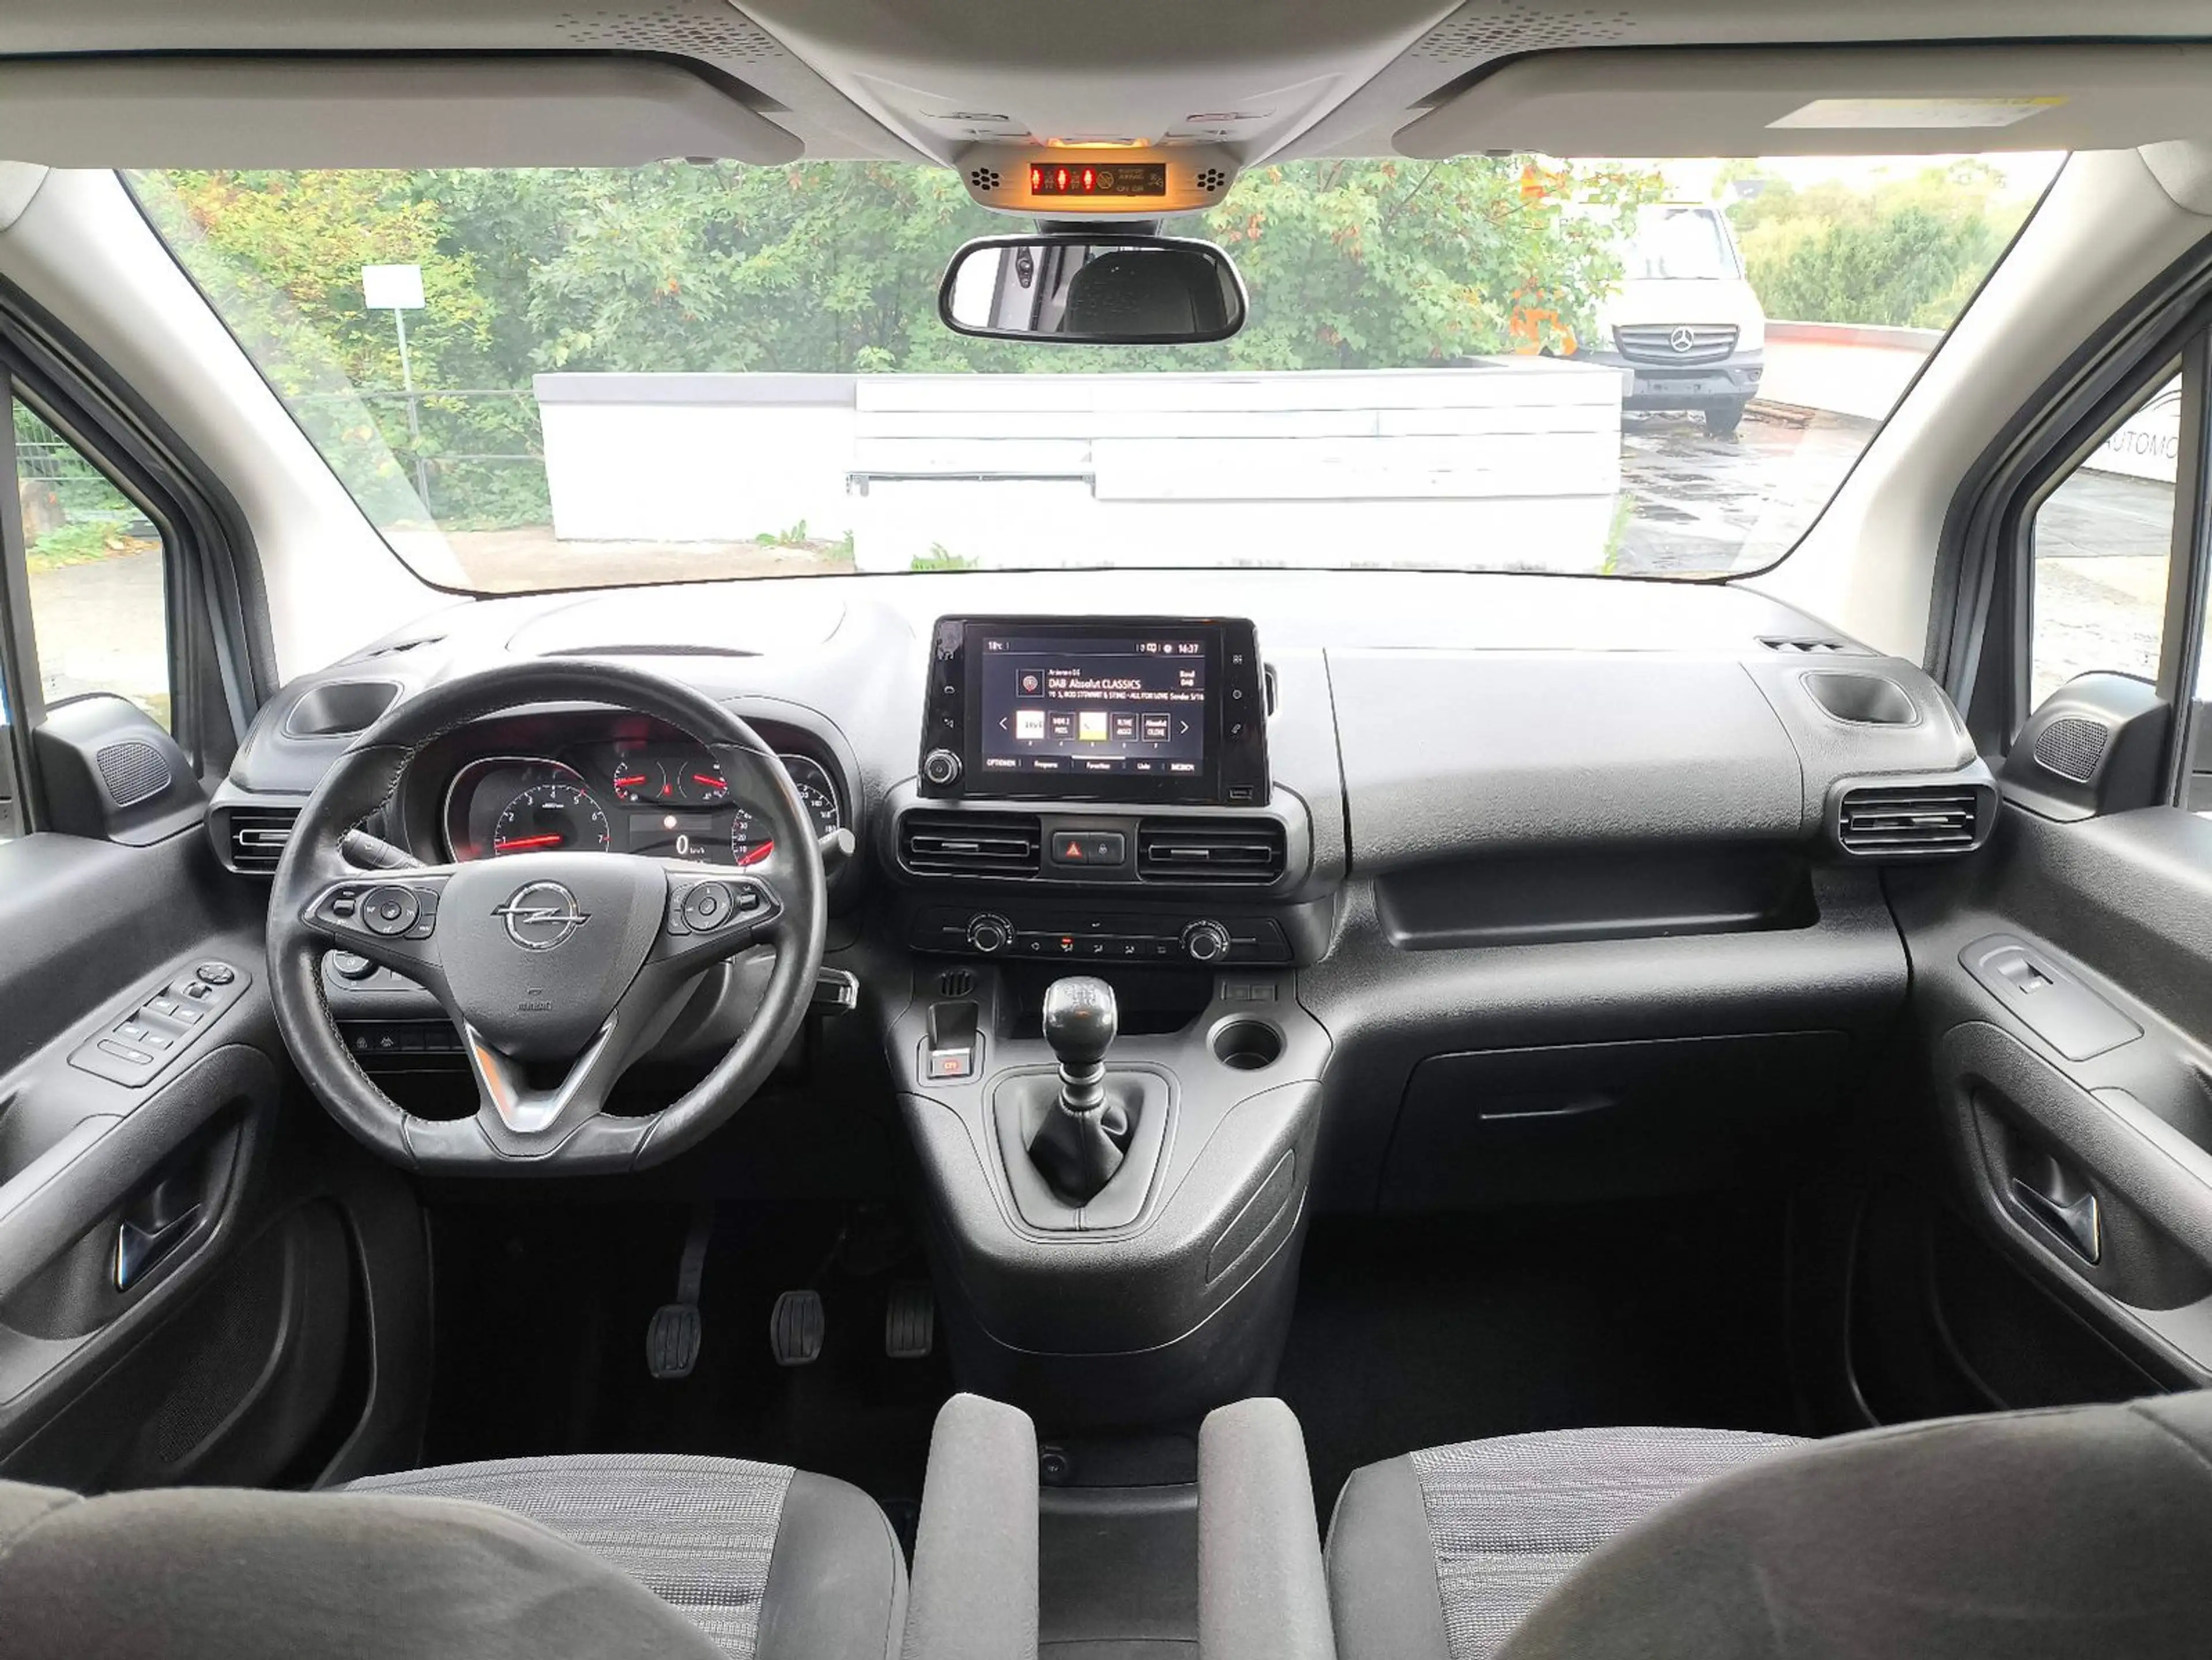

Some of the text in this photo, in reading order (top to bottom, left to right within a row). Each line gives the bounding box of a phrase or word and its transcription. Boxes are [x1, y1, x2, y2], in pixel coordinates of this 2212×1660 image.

[1048, 678, 1141, 690] DAB Absolut CLASSICS
[527, 795, 533, 806] 3
[508, 812, 515, 822] 2
[591, 812, 597, 821] 6
[597, 835, 604, 844] 7
[676, 835, 689, 855] 0
